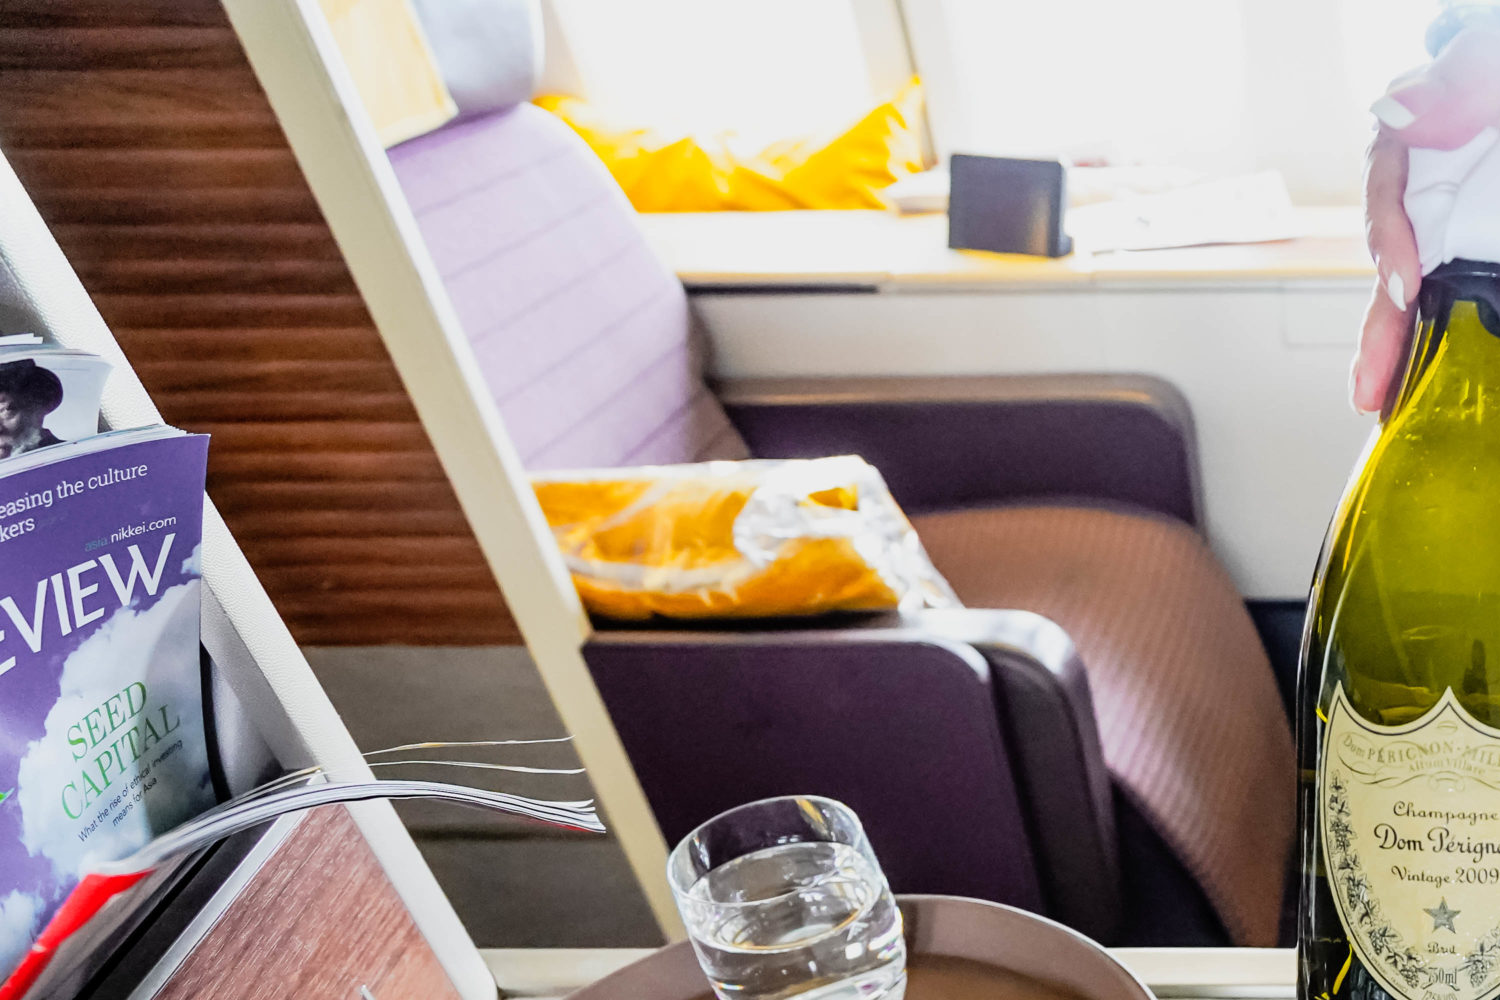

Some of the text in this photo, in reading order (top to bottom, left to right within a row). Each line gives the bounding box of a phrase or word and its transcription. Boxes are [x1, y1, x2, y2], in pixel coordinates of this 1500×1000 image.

[56, 480, 85, 500] the
[88, 464, 148, 490] culture
[67, 681, 147, 763] SEED
[61, 704, 180, 820] CAPITAL
[78, 819, 98, 842] What
[97, 807, 110, 823] the
[109, 795, 121, 811] rise
[122, 783, 130, 798] of
[130, 763, 151, 789] ethical
[112, 777, 157, 827] means for Asia
[1393, 801, 1500, 827] Champagne
[1373, 823, 1424, 852] Dom
[1391, 865, 1500, 889] Vintage 2009
